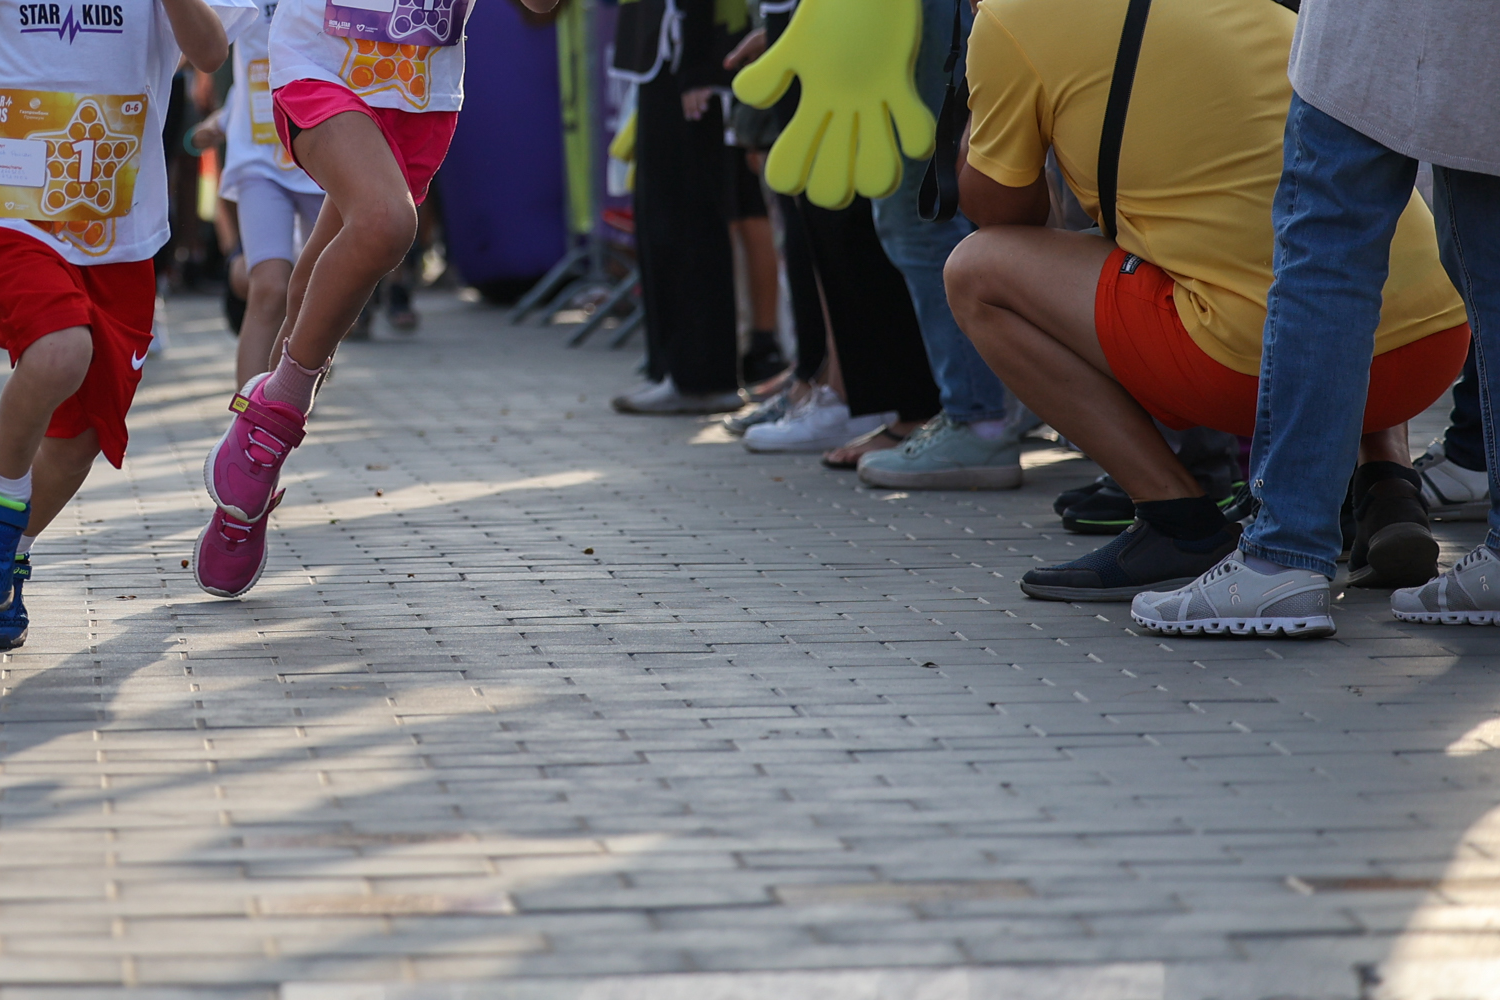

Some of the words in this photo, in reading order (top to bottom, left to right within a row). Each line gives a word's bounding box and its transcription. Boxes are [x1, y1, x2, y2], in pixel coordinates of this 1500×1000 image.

[20, 3, 60, 26] STAR
[82, 4, 123, 26] KIDS
[125, 103, 139, 113] 0-6
[71, 138, 96, 184] 1
